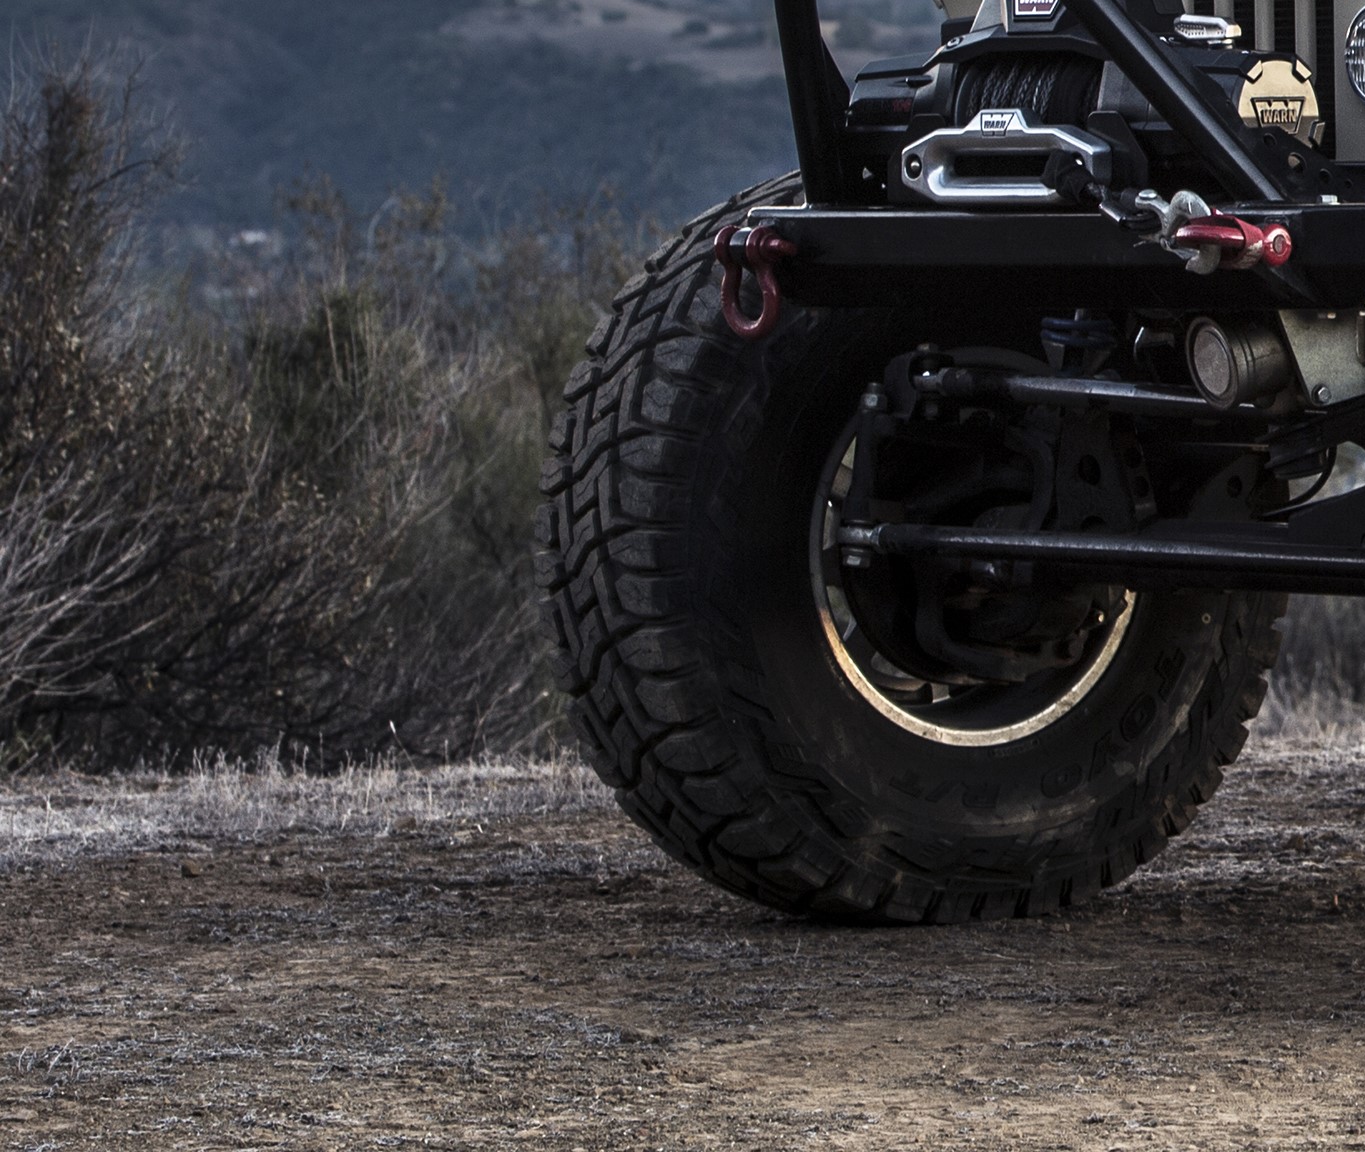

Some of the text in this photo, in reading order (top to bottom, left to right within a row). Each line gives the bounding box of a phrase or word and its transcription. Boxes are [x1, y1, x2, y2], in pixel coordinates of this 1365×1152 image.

[1260, 108, 1298, 124] WARN
[983, 120, 1007, 129] WARN
[1040, 646, 1187, 799] TOYO
